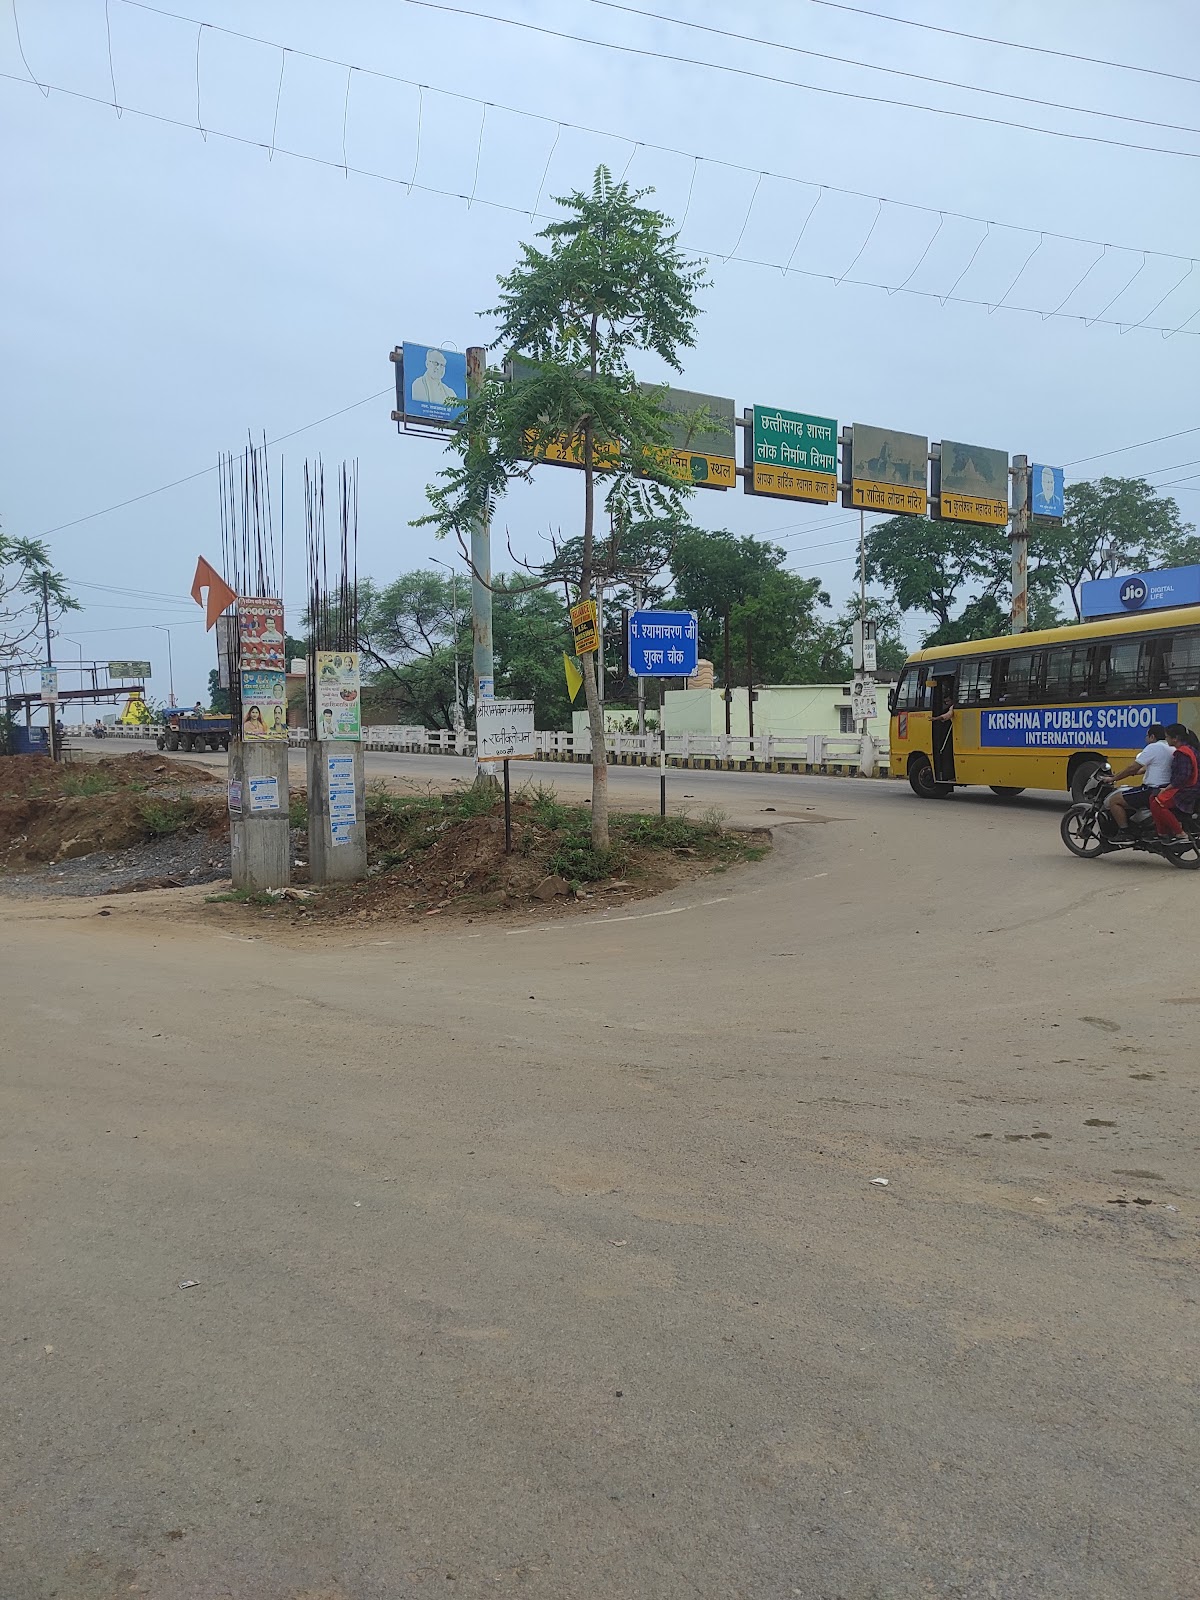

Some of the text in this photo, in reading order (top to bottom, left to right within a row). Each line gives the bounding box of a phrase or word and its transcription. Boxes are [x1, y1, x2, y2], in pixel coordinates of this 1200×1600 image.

[761, 412, 831, 441] छत्तीसगढ़ शासन
[556, 449, 567, 460] 22
[757, 438, 835, 469] लोक निर्माण विभाग
[710, 463, 731, 478] स्थल
[757, 471, 835, 496] आपका हार्दिक स्वागत करता है
[888, 487, 905, 508] लोचन
[907, 490, 922, 510] मंदिर
[976, 500, 992, 517] महादेव
[993, 501, 1006, 519] मंदिर
[1122, 584, 1144, 601] Jio
[1150, 585, 1174, 594] DIGITAL
[631, 620, 695, 640] पं. श्यामाचरण जी
[643, 644, 684, 670] शुक्ल चौक
[988, 707, 1161, 730] KRISHNA PUBLIC SCHOOL
[1025, 731, 1108, 745] INTERNATIONAL
